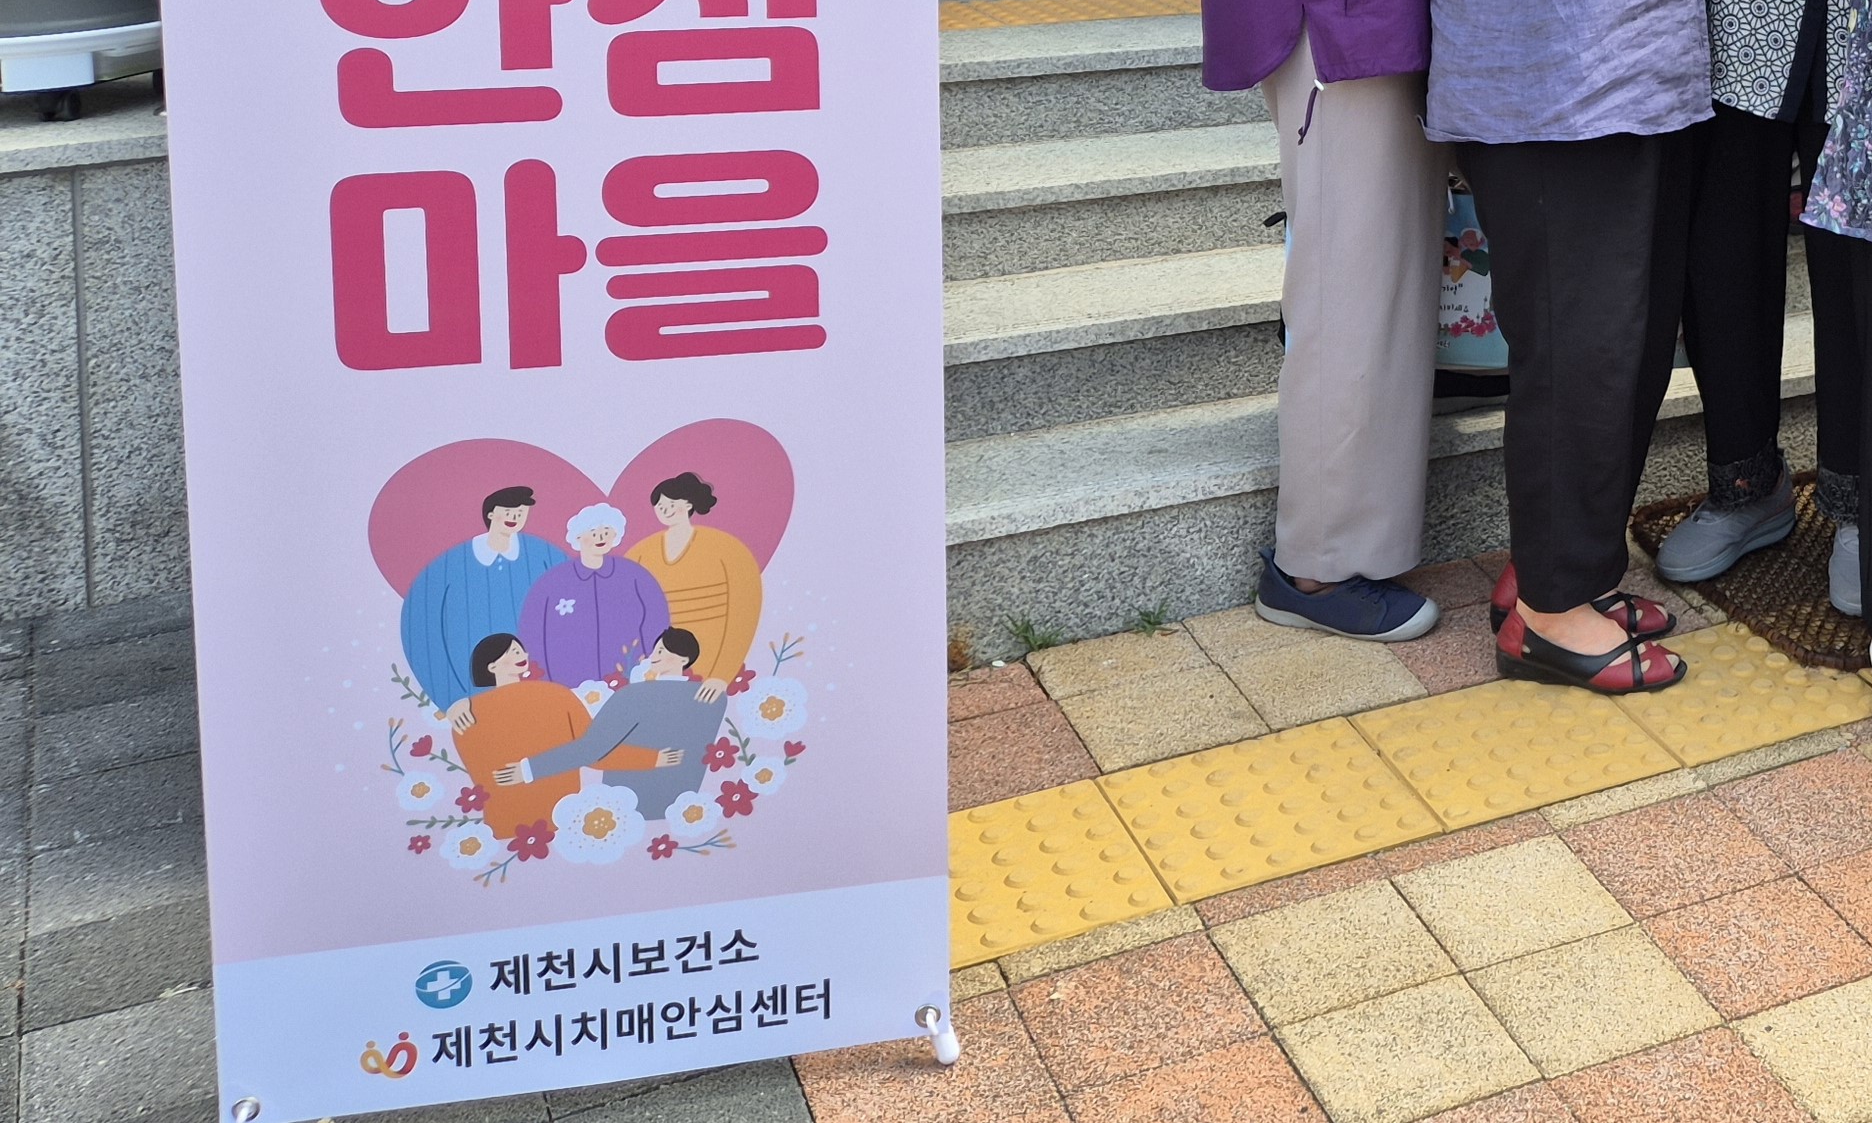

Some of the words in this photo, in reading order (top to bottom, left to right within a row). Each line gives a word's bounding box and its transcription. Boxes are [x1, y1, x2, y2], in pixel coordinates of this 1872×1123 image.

[330, 149, 829, 371] 마을
[489, 928, 760, 996] 제천시보건소
[431, 978, 833, 1069] 제천시치매안심센터
